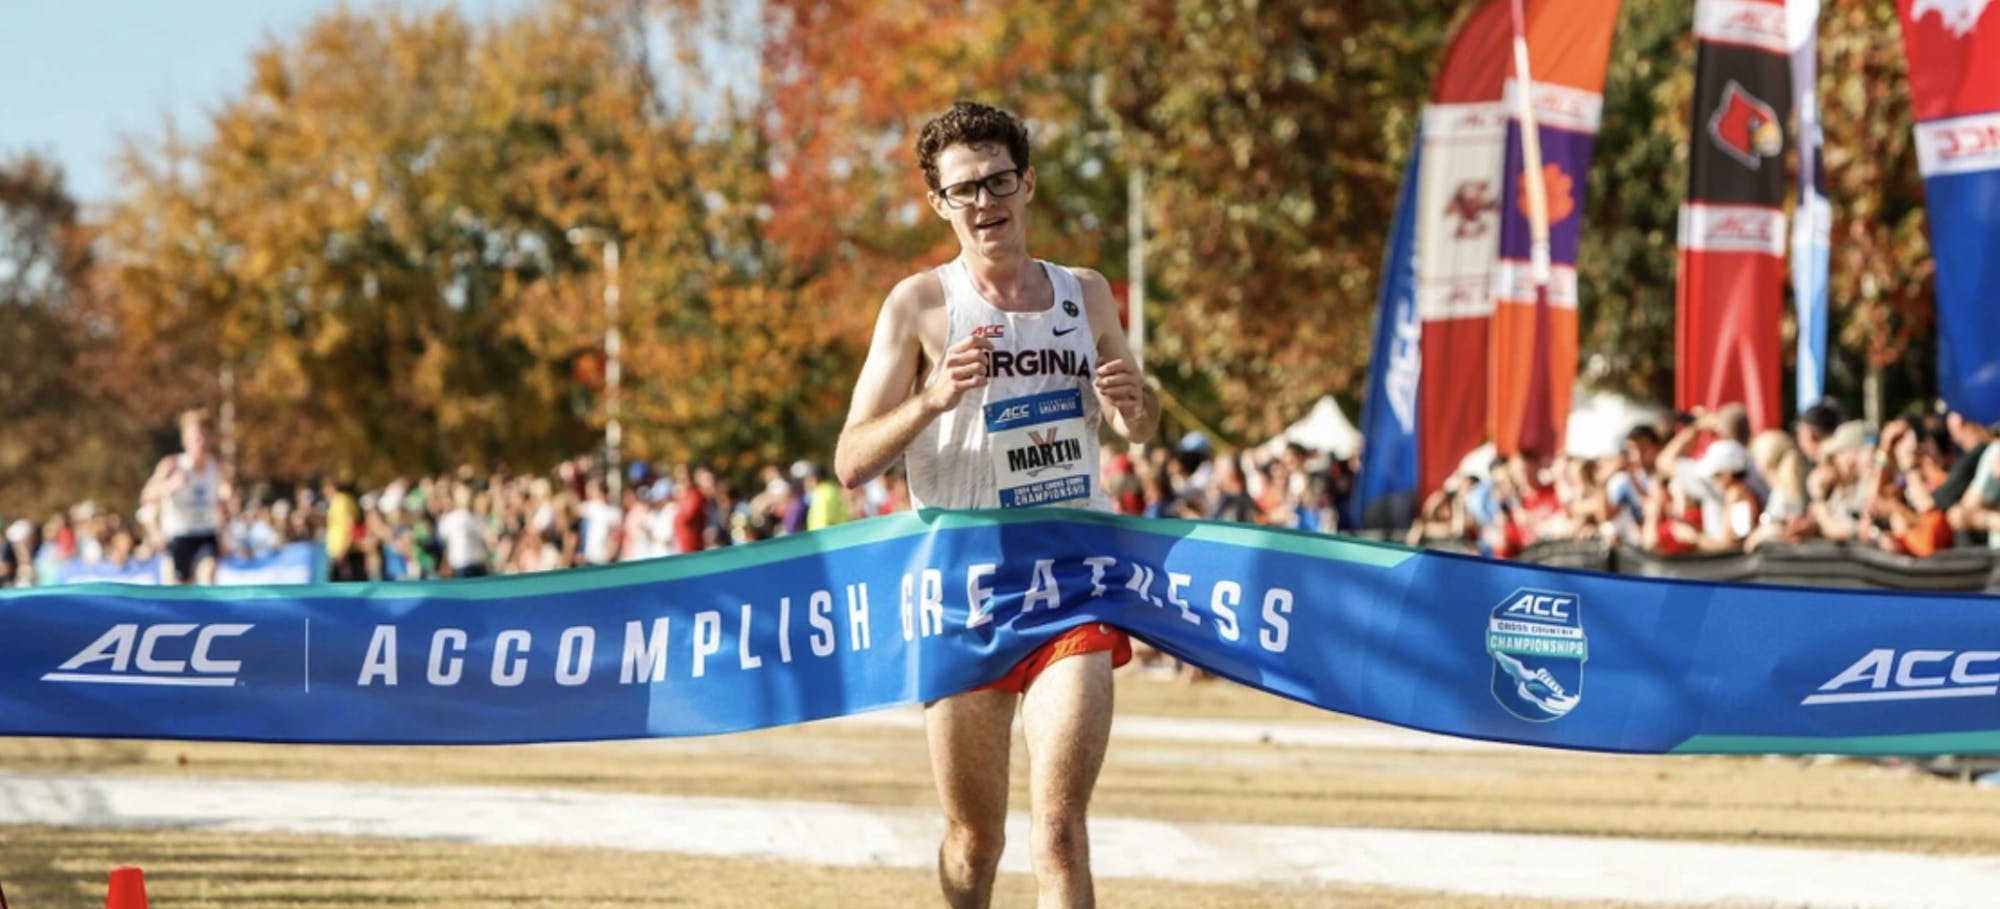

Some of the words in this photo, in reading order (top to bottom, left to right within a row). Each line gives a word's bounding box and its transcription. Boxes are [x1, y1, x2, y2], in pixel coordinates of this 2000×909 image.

[970, 324, 1005, 337] ACC
[984, 349, 1091, 379] IRGINIA
[996, 404, 1030, 422] ACC
[1007, 438, 1082, 472] MARTIN
[1507, 593, 1572, 619] ACC
[57, 624, 255, 673] ACC
[357, 582, 871, 687] ACCOMPLISH
[1489, 634, 1584, 655] CHAMPIONSHIPS
[1817, 649, 2000, 690] ACC
